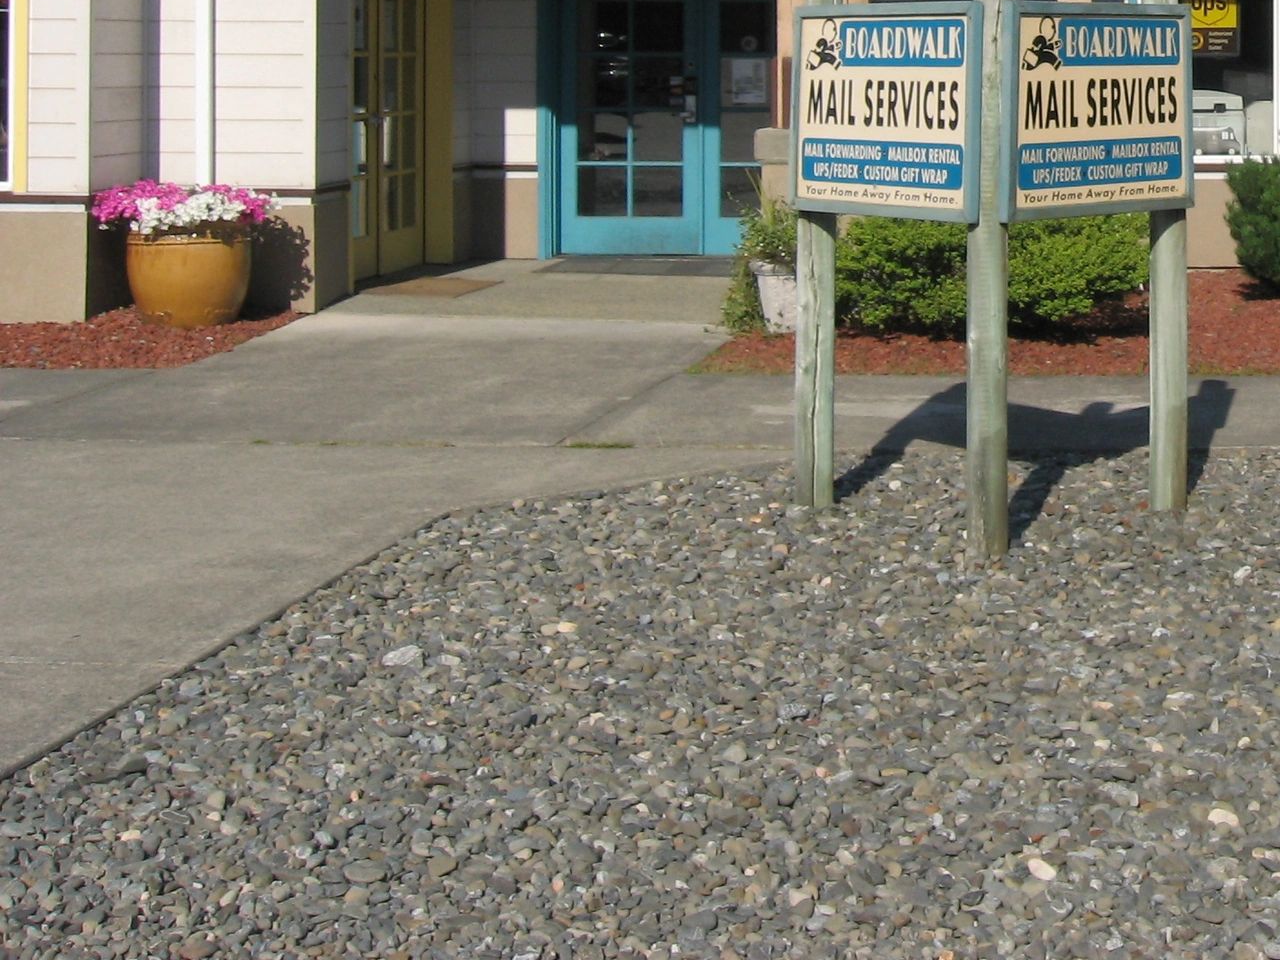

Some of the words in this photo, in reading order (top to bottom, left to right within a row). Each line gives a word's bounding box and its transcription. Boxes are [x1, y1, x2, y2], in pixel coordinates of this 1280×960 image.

[846, 26, 962, 60] BOARDWALK
[1066, 26, 1178, 59] BOARDWALK
[807, 79, 855, 126] MAIL
[864, 79, 959, 131] SERVICES
[1025, 80, 1079, 130] MAIL
[1087, 76, 1177, 128] SERVICES
[804, 142, 824, 158] MAIL
[825, 143, 882, 161] FORWARDING
[888, 146, 926, 163] MAILBOX
[929, 148, 960, 165] RENTAL
[1021, 148, 1043, 165] MAIL
[1045, 145, 1106, 163] FORWARDING
[1112, 142, 1149, 159] MAILBOX
[1151, 141, 1179, 156] RENTAL
[813, 162, 858, 180] UPS/FEDEX
[864, 164, 899, 182] CUSTOM
[901, 167, 920, 183] GIFT
[921, 168, 948, 185] WRAP
[1033, 167, 1081, 186] UPS/FEDEX
[1087, 164, 1124, 181] CUSTOM
[1125, 162, 1143, 178] GIFT
[1145, 160, 1168, 176] WRAP
[806, 185, 826, 196] Your
[830, 186, 859, 198] Home
[861, 188, 891, 202] Away
[895, 190, 920, 202] From
[924, 192, 958, 205] Home.
[1023, 192, 1048, 204] Your
[1052, 190, 1082, 202] Home
[1086, 188, 1115, 200] Away
[1119, 186, 1144, 196] From
[1147, 184, 1179, 194] Home.
